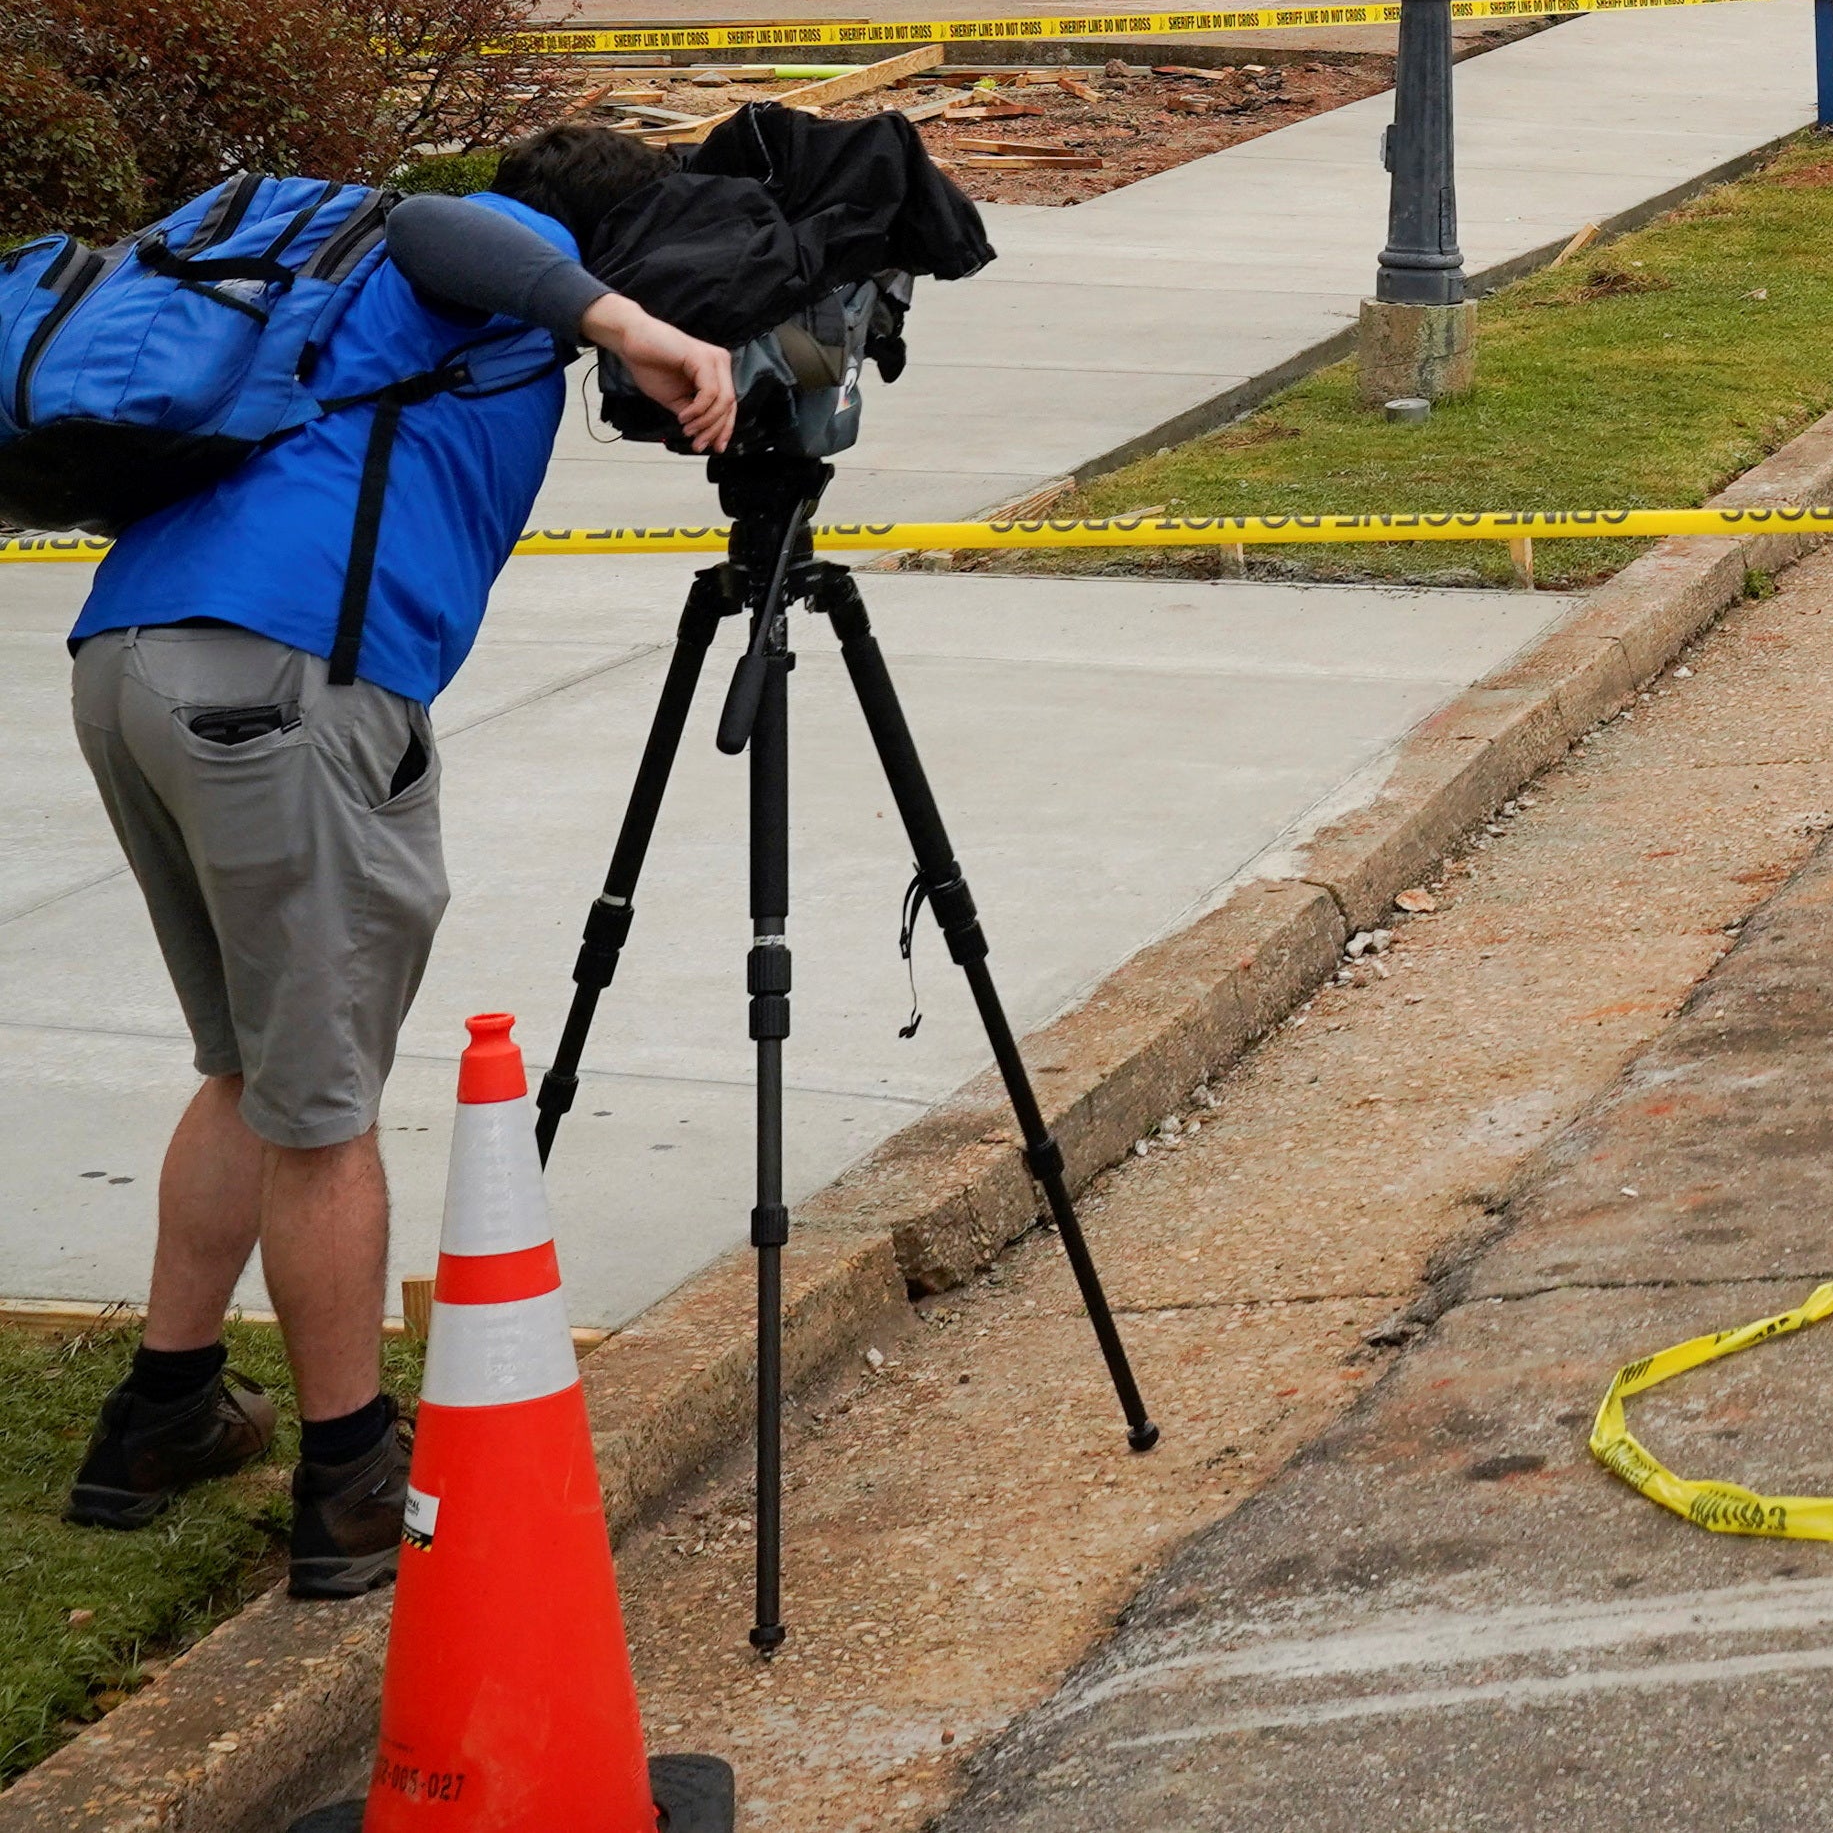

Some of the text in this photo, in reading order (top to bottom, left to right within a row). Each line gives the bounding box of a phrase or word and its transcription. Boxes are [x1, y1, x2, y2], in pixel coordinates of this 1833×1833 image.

[1384, 7, 1401, 20] SHER
[1452, 3, 1474, 17] CROSS
[1490, 1, 1516, 15] SHERIFF
[1518, 0, 1532, 14] LINE
[1533, 0, 1542, 13] DO
[1544, 0, 1556, 13] NOT
[1168, 13, 1260, 29] SHERIFF LINE DO NOT CROSS
[1276, 8, 1366, 25] SHERIFF LINE DO NOT CROSS
[839, 25, 932, 41] SHERIFF LINE DO NOT CROSS
[950, 21, 1042, 37] SHERIFF LINE DO NOT CROSS
[1059, 17, 1152, 34] SHERIFF LINE DO NOT CROSS
[614, 31, 710, 47] SHERIFF LINE DO NOT CROSS
[727, 28, 822, 44] SHERIFF LINE DO NOT CROSS
